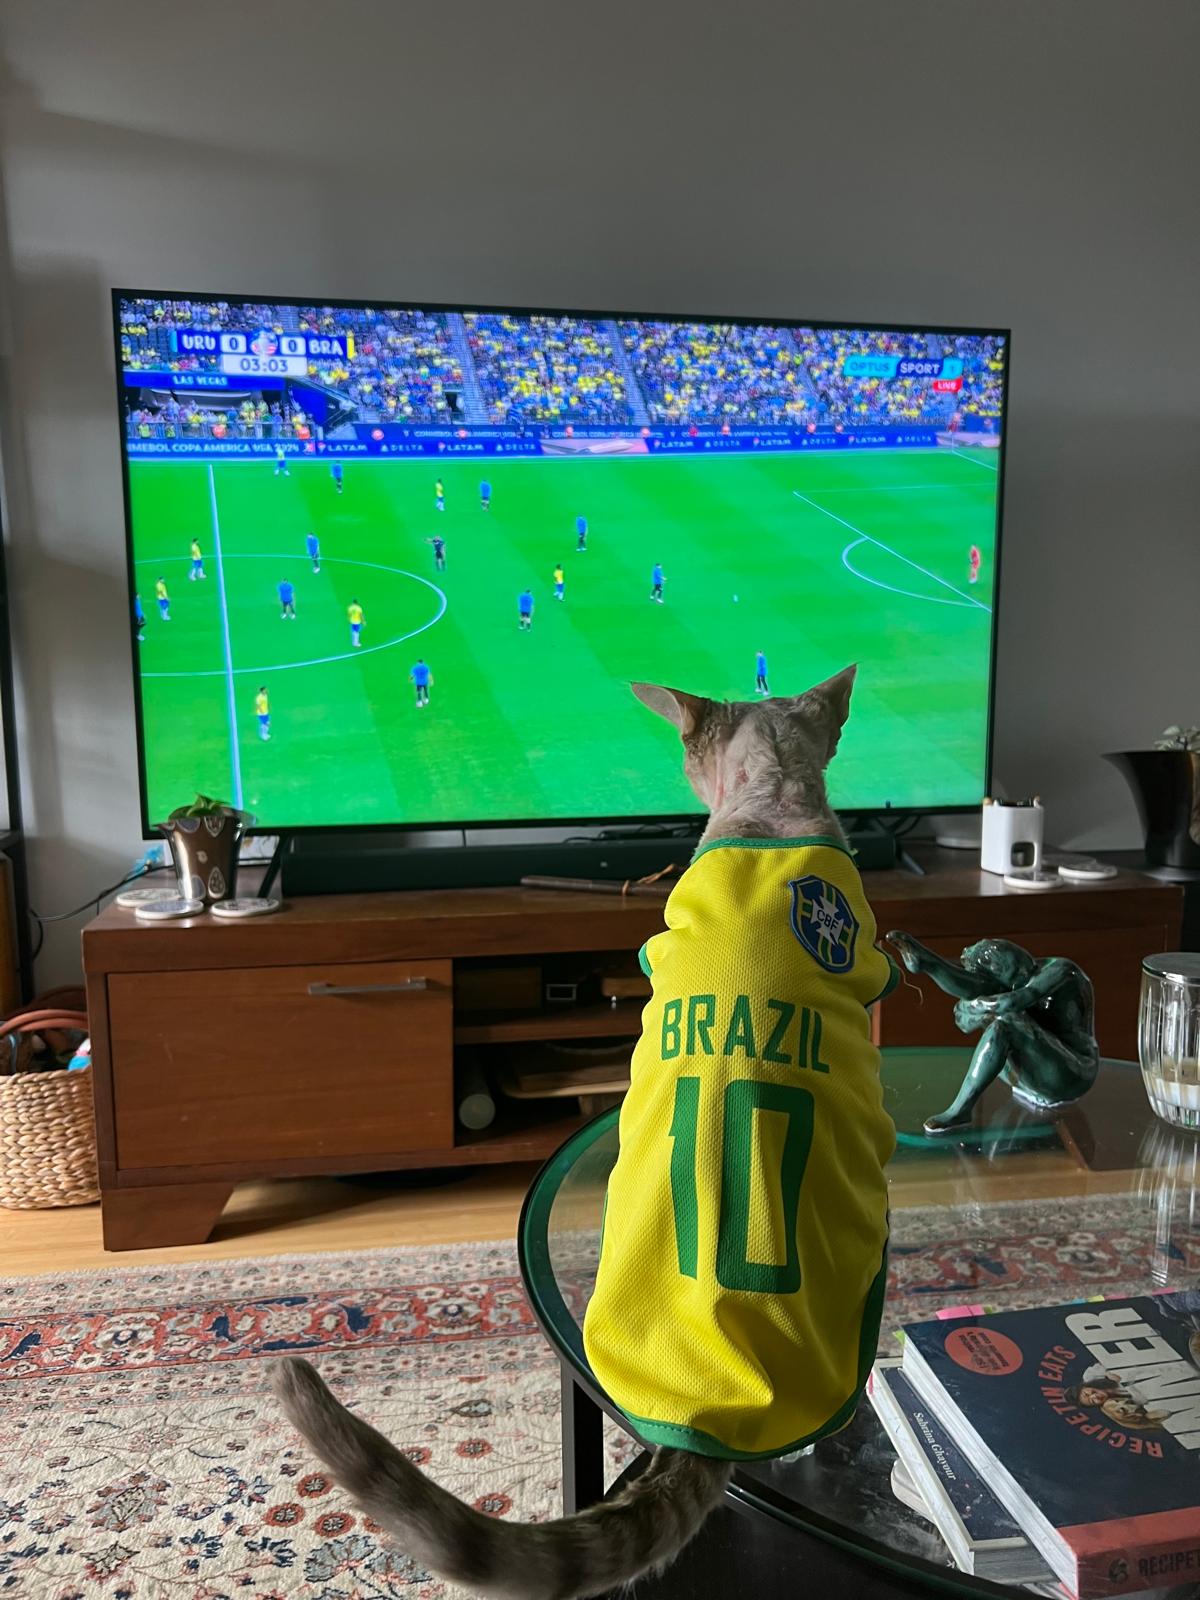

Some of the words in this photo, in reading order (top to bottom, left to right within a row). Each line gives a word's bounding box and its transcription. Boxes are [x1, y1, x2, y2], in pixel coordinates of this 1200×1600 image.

[181, 334, 216, 351] URU
[228, 337, 238, 350] 0
[287, 339, 298, 352] 0
[308, 339, 343, 356] BRA
[240, 358, 288, 373] 03:03
[900, 362, 940, 374] SPORT
[173, 376, 194, 385] LAS
[197, 376, 227, 386] VEGAS
[938, 381, 957, 390] LIVE
[172, 443, 200, 453] COPA
[204, 443, 250, 453] AMERICA
[817, 910, 838, 930] CBF
[661, 994, 830, 1073] BRAZIL
[668, 1076, 814, 1294] 10
[1039, 1345, 1076, 1382] EATS
[913, 1412, 936, 1444] Sabrina
[931, 1443, 957, 1481] Ghayour
